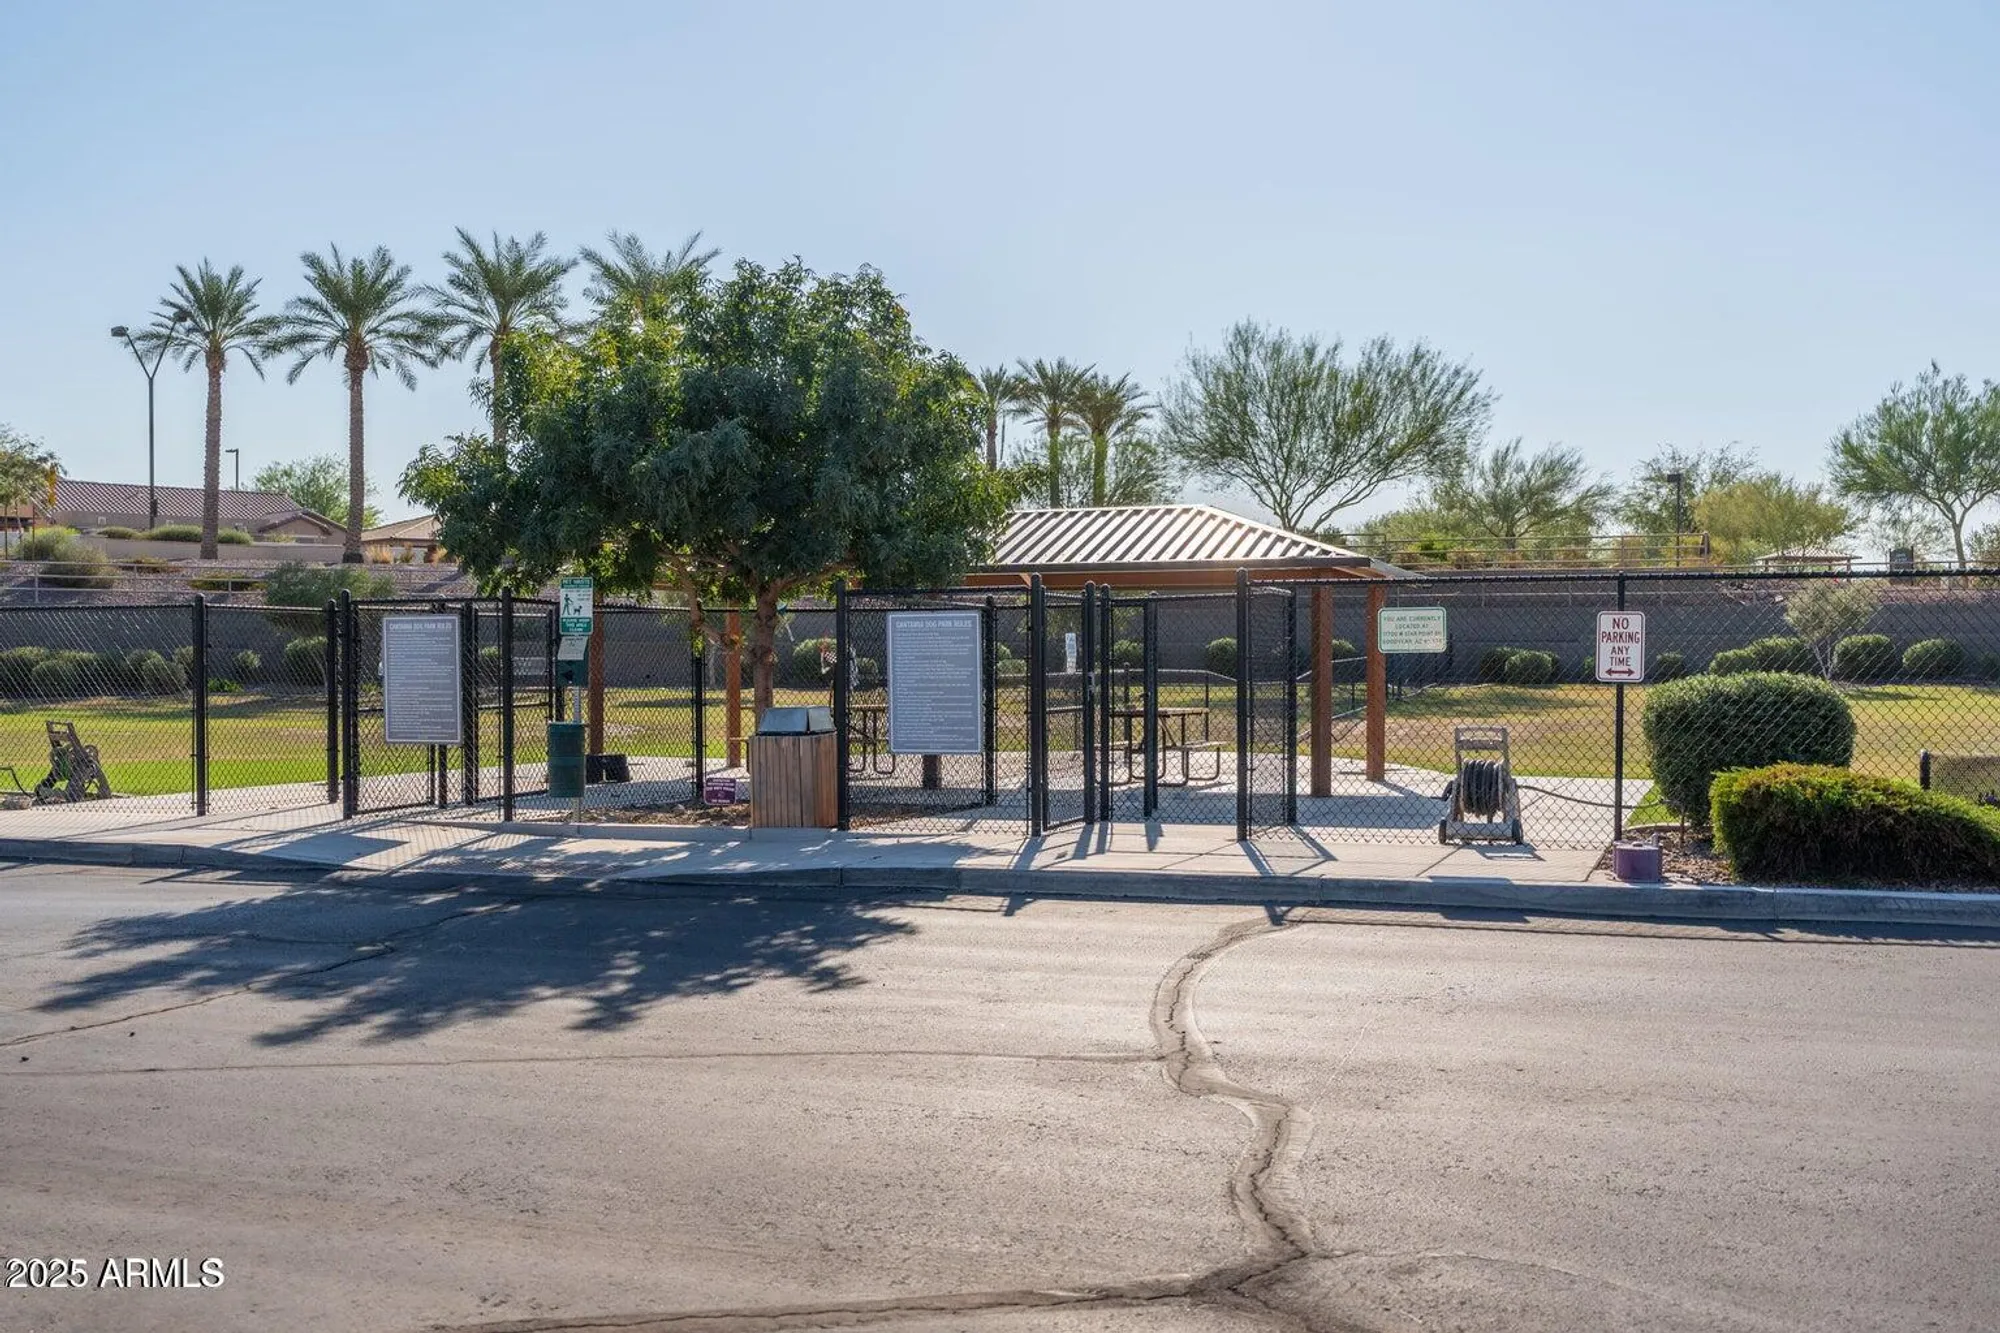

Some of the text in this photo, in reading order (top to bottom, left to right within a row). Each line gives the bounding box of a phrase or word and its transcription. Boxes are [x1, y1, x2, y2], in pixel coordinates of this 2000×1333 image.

[1612, 618, 1629, 629] NO
[1601, 631, 1640, 644] PARKING
[1611, 646, 1630, 655] ANY
[1610, 657, 1631, 666] TIME
